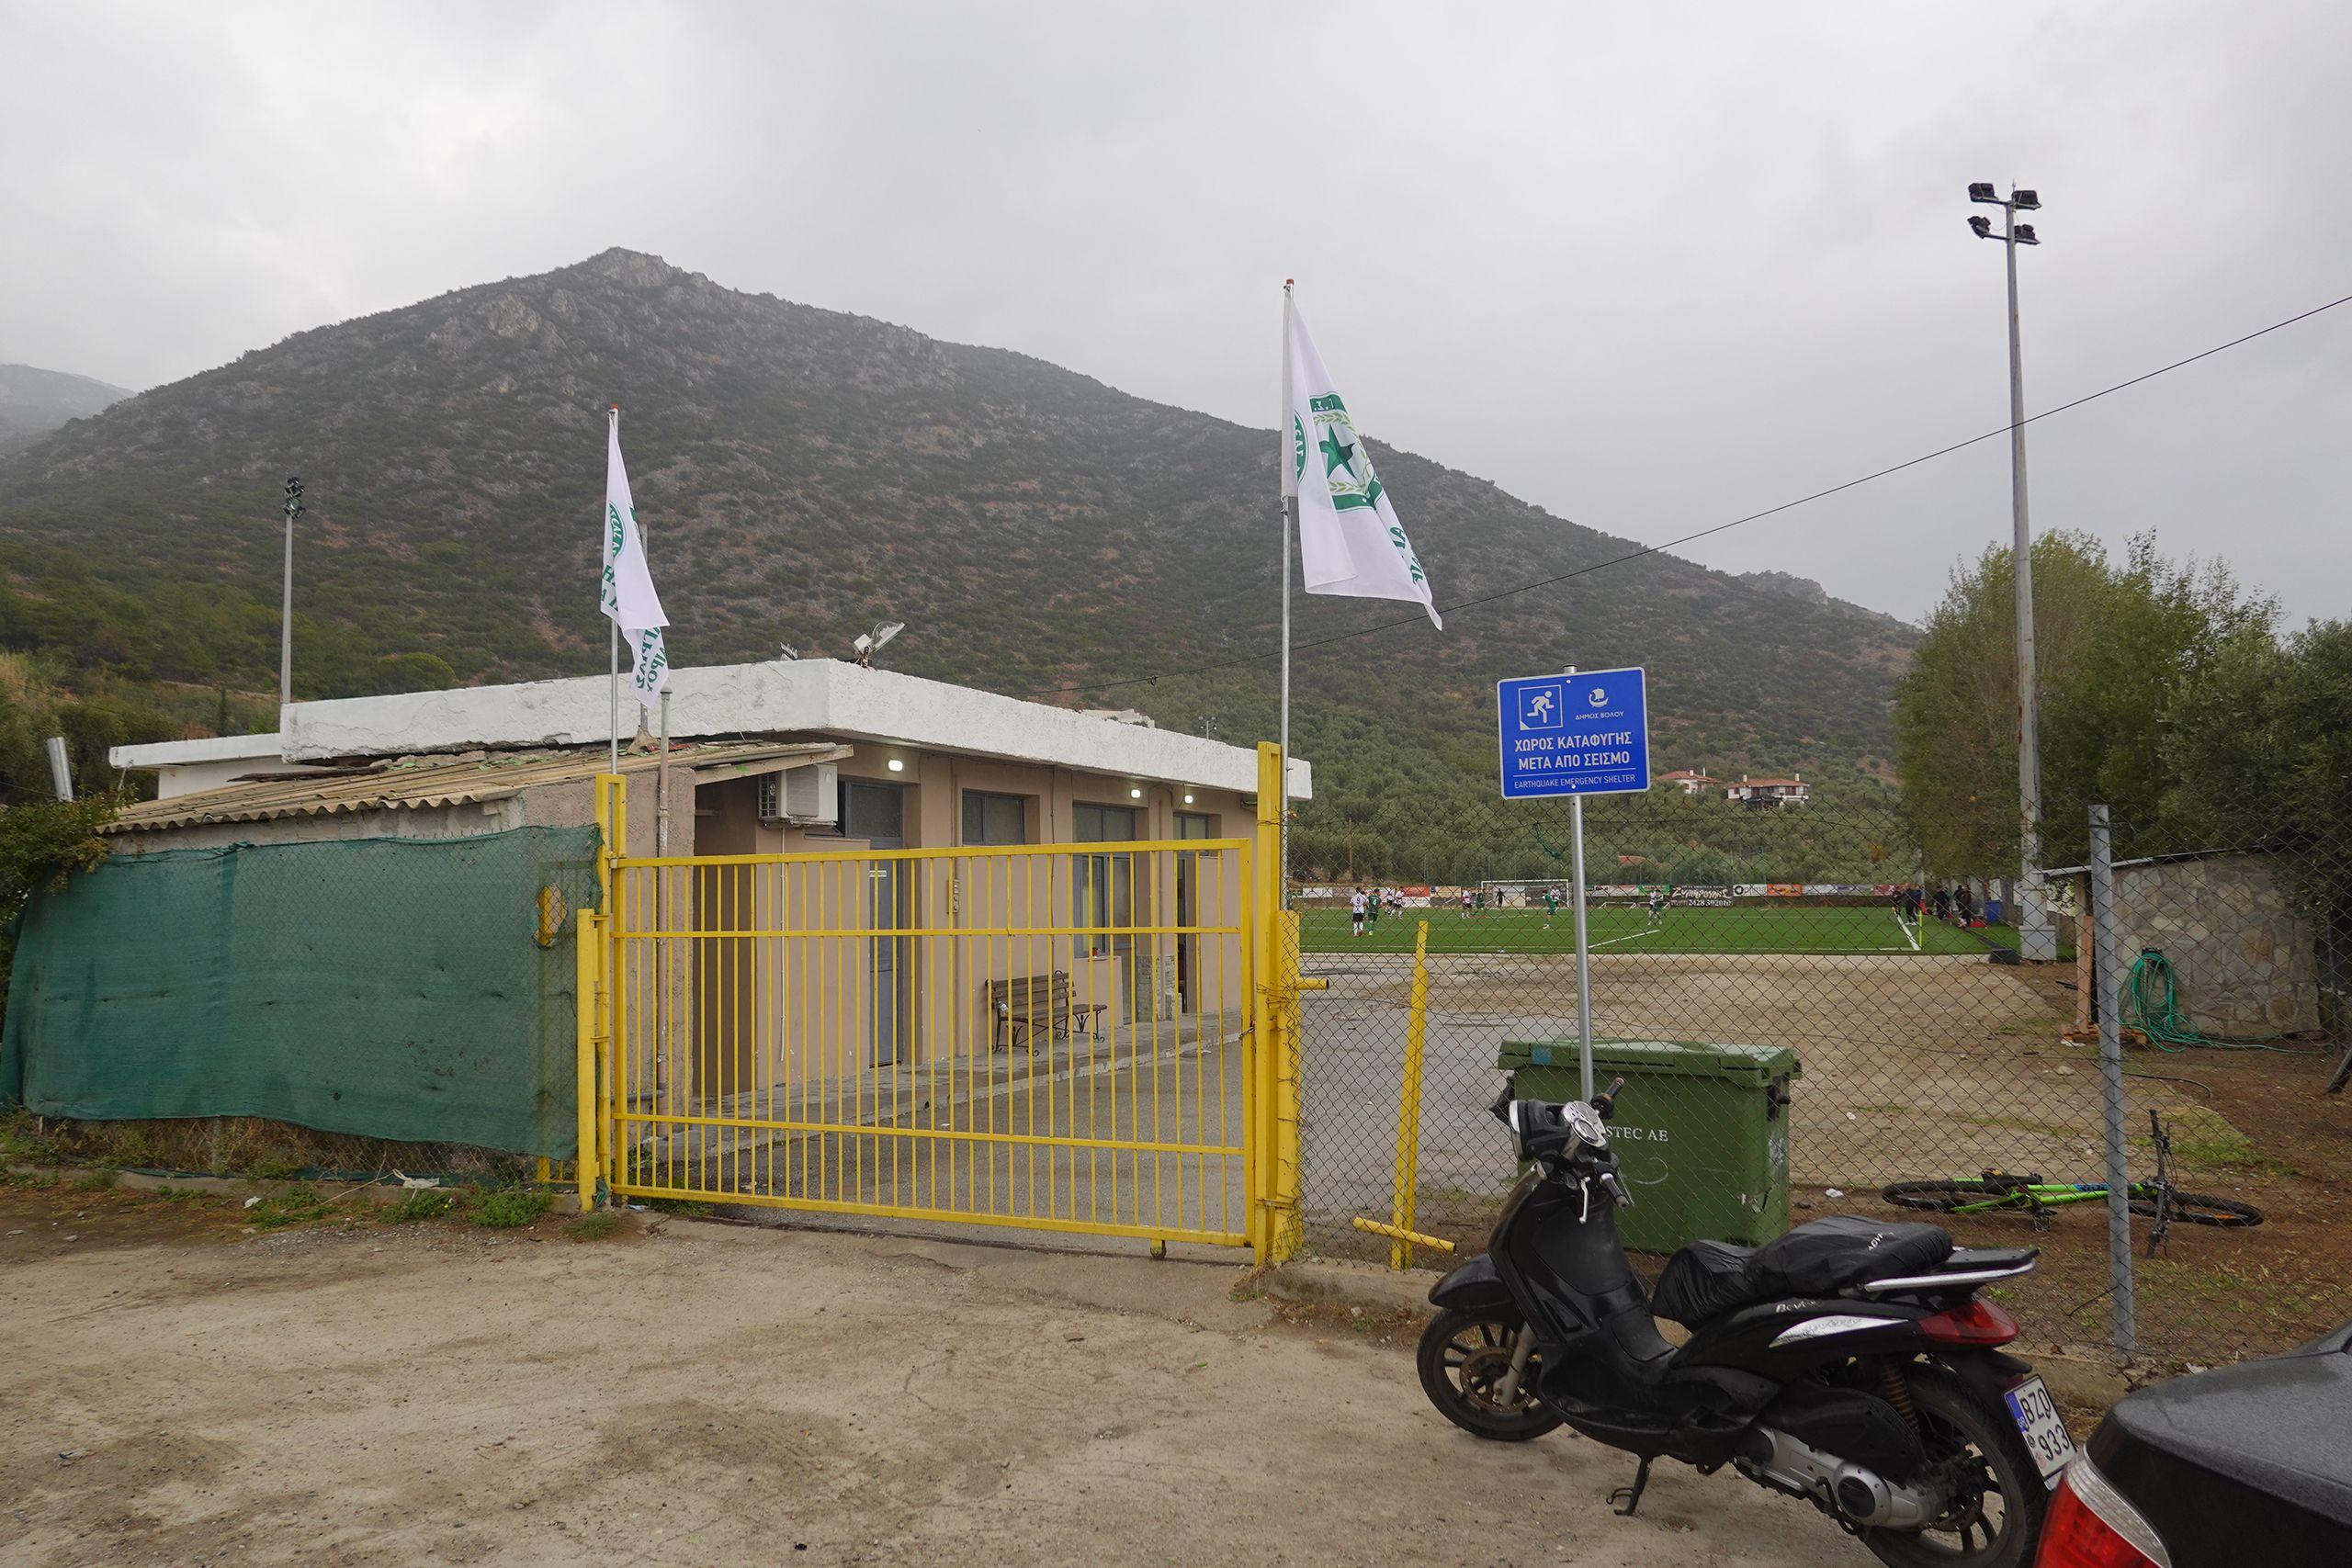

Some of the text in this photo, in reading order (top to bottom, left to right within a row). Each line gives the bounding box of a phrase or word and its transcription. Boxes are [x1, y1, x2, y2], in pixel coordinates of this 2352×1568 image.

[1515, 732, 1633, 752] ΧΩΡΟΣ ΚΑΤΑΦΥΓΗΣ
[1519, 751, 1630, 771] ΜΕΤΑ ΑΠΟ ΣΕΙΣΜΟ
[1514, 774, 1635, 789] EARTHQUAKE EMERGENCY SHELTER
[1648, 1129, 1668, 1142] AE
[2039, 1424, 2069, 1461] 933
